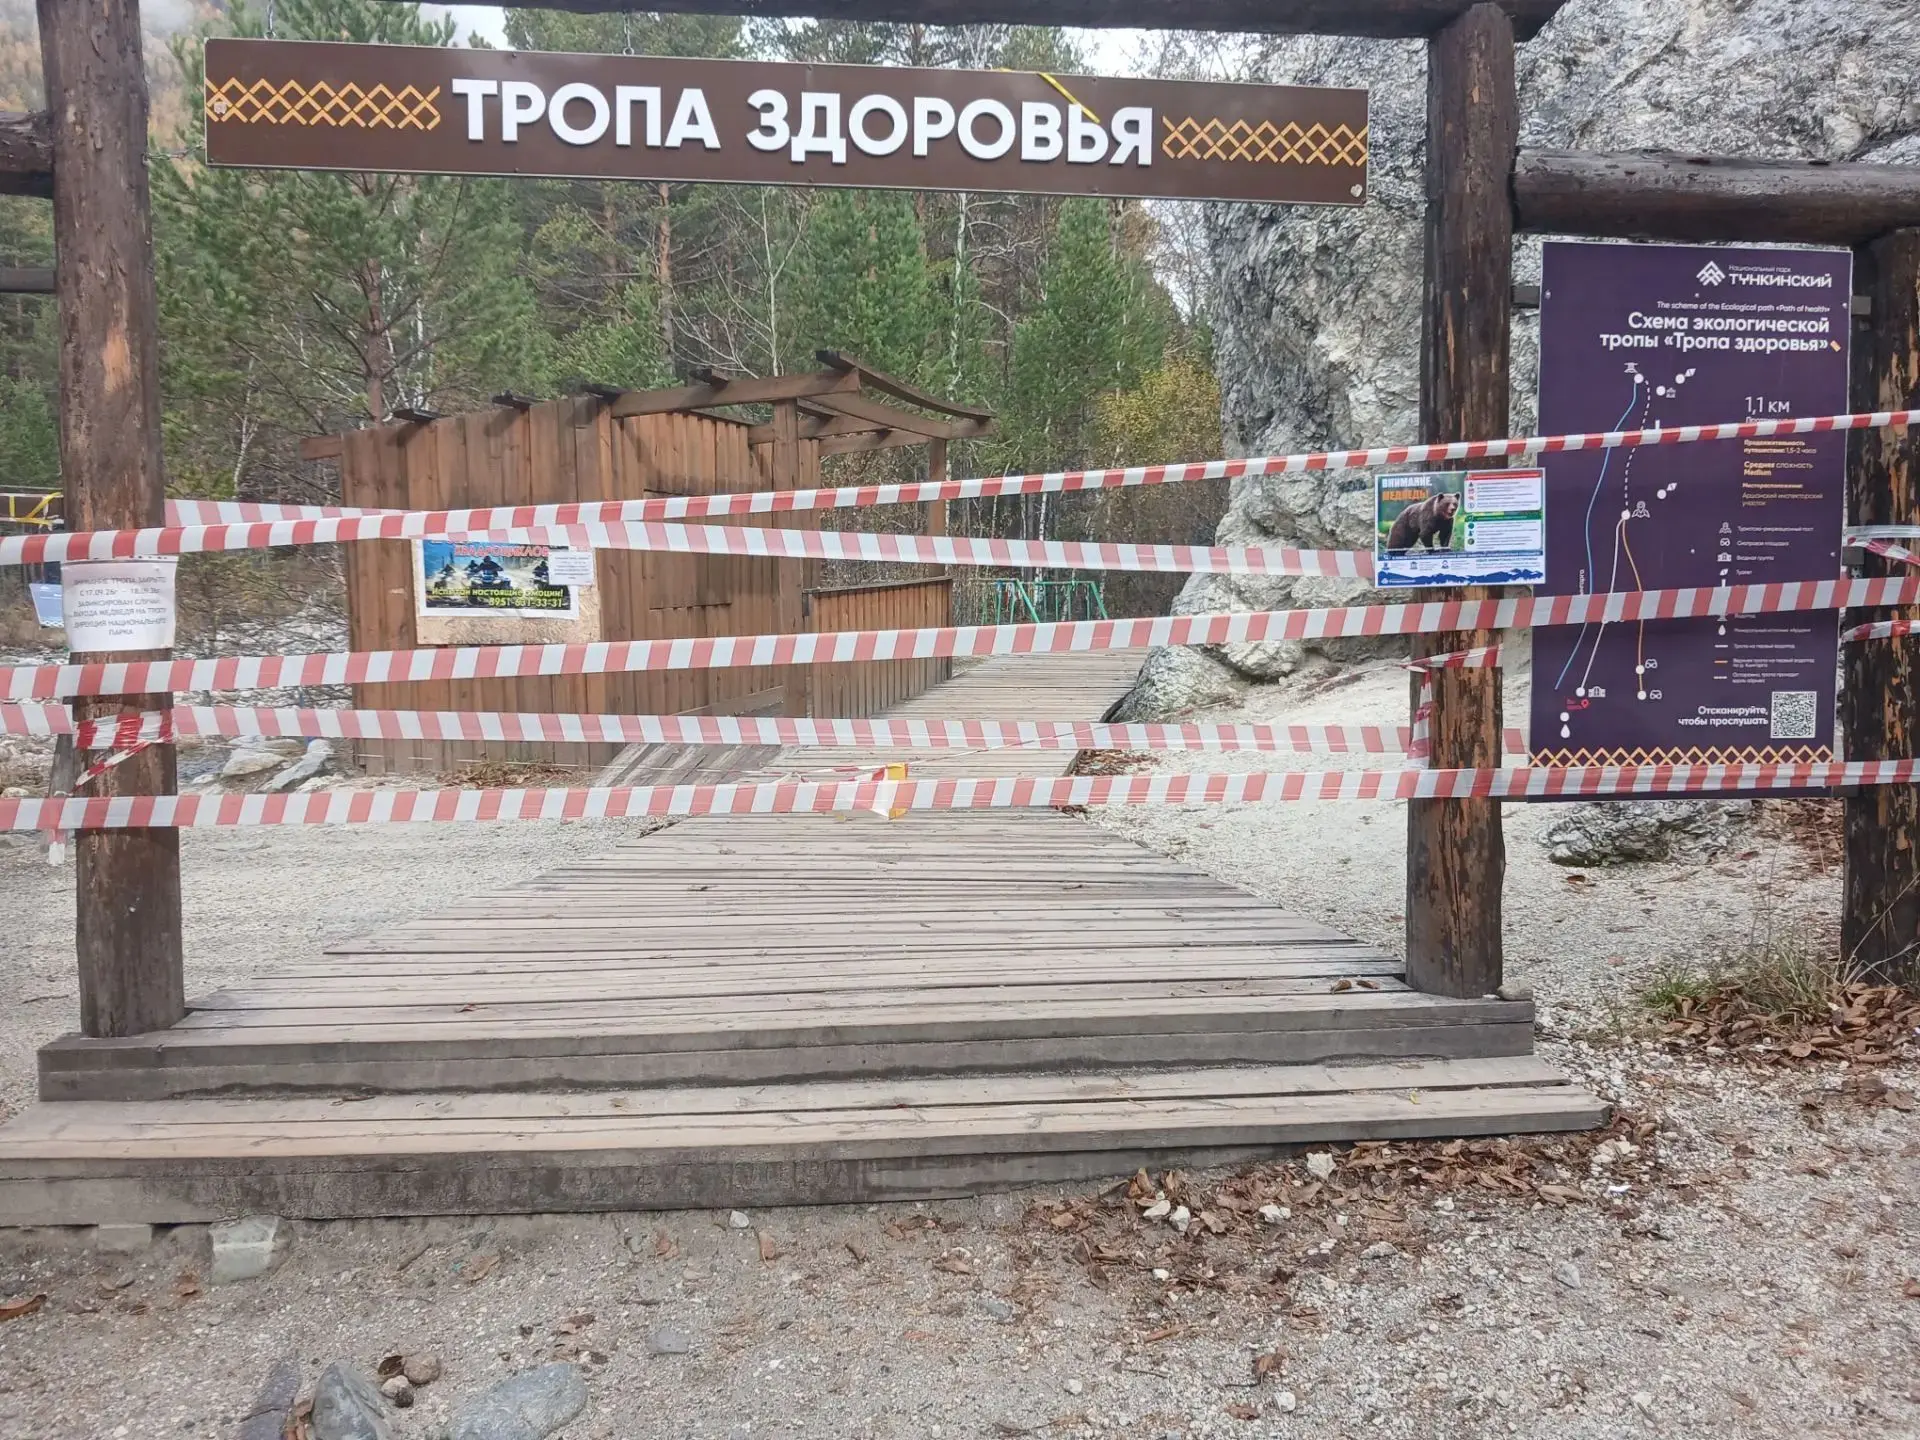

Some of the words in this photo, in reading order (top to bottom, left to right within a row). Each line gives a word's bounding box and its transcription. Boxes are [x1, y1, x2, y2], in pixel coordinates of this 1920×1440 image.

[452, 78, 722, 150] ТРОПА
[746, 88, 1154, 166] ЗДОРОВЬЯ
[1657, 301, 1670, 309] The
[1671, 302, 1698, 310] scheme
[1699, 302, 1707, 310] of
[1708, 302, 1720, 310] the
[1721, 302, 1757, 312] Ecological
[1757, 303, 1774, 313] path
[1796, 304, 1804, 312] of
[1628, 312, 1689, 330] Схема
[1692, 316, 1830, 333] экологической
[1600, 334, 1659, 350] тропы
[1664, 332, 1731, 352] «Тропа
[1734, 336, 1828, 354] здоровья»
[1745, 396, 1764, 415] 1,1
[1697, 705, 1769, 717] Отсканируйте,
[1678, 717, 1708, 727] чтобы
[1709, 717, 1769, 727] прослушать
